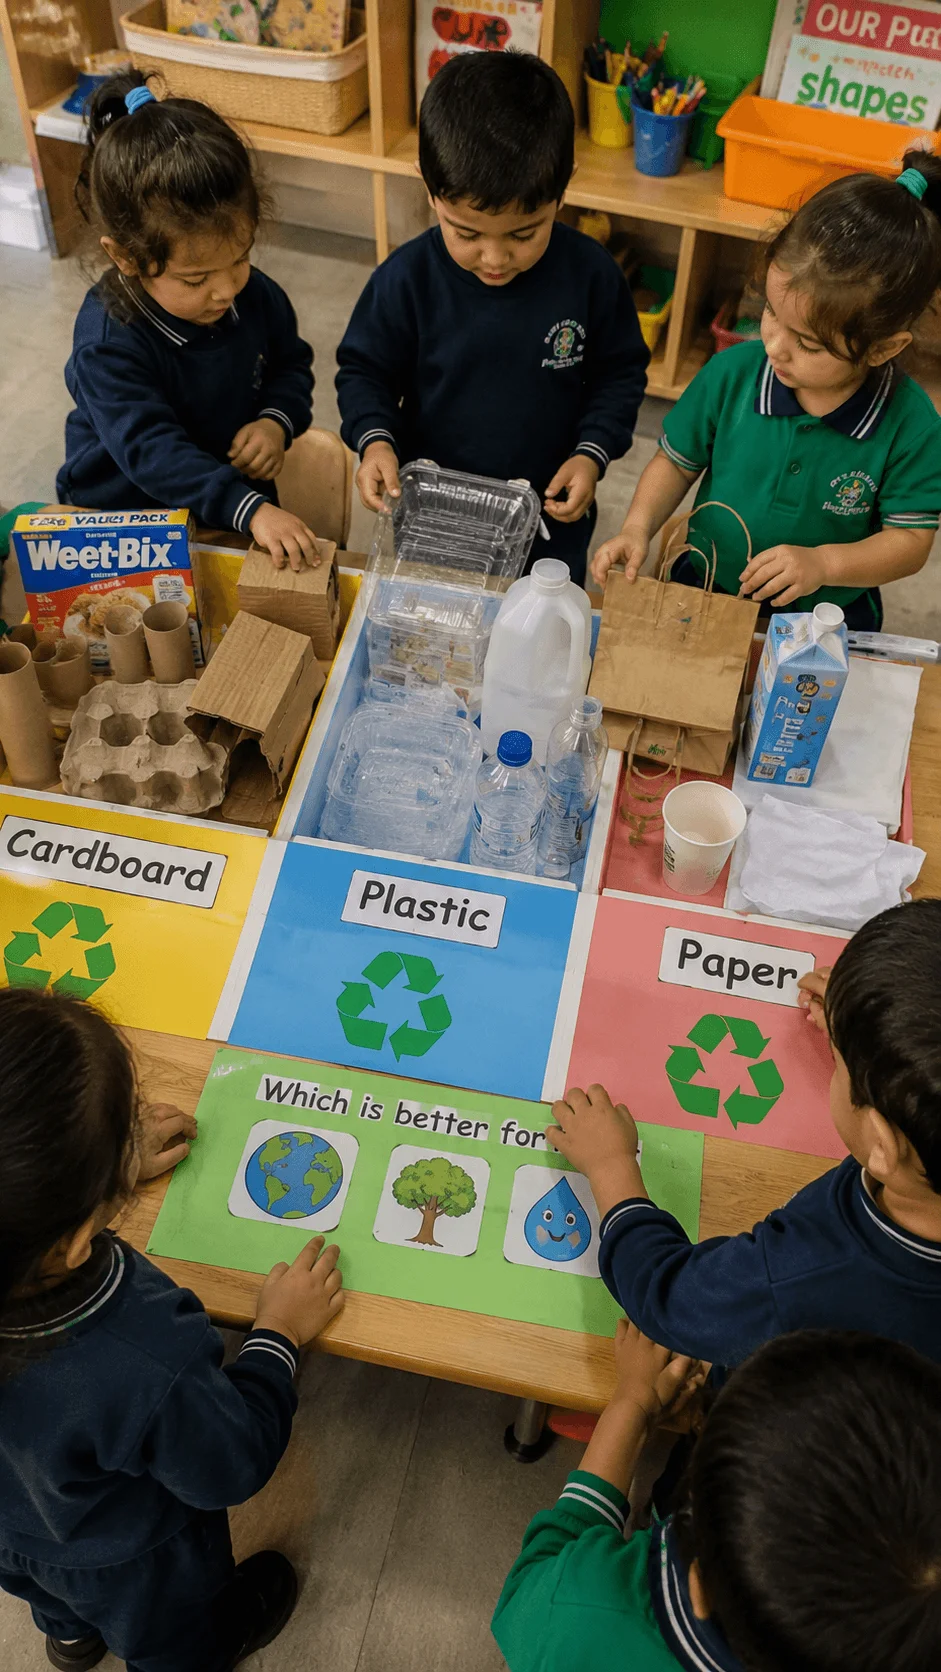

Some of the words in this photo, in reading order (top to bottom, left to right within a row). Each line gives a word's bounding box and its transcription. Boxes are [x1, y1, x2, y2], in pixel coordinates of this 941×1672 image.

[816, 3, 881, 40] OUR
[798, 64, 929, 123] shapes
[129, 514, 168, 523] PACK
[26, 537, 173, 571] Weet-Bix
[6, 828, 213, 892] Cardboard
[359, 880, 490, 932] Plastic
[677, 938, 798, 990] Paper
[264, 1077, 348, 1115] Which
[359, 1095, 384, 1120] is
[394, 1101, 489, 1138] better
[501, 1121, 546, 1148] for
